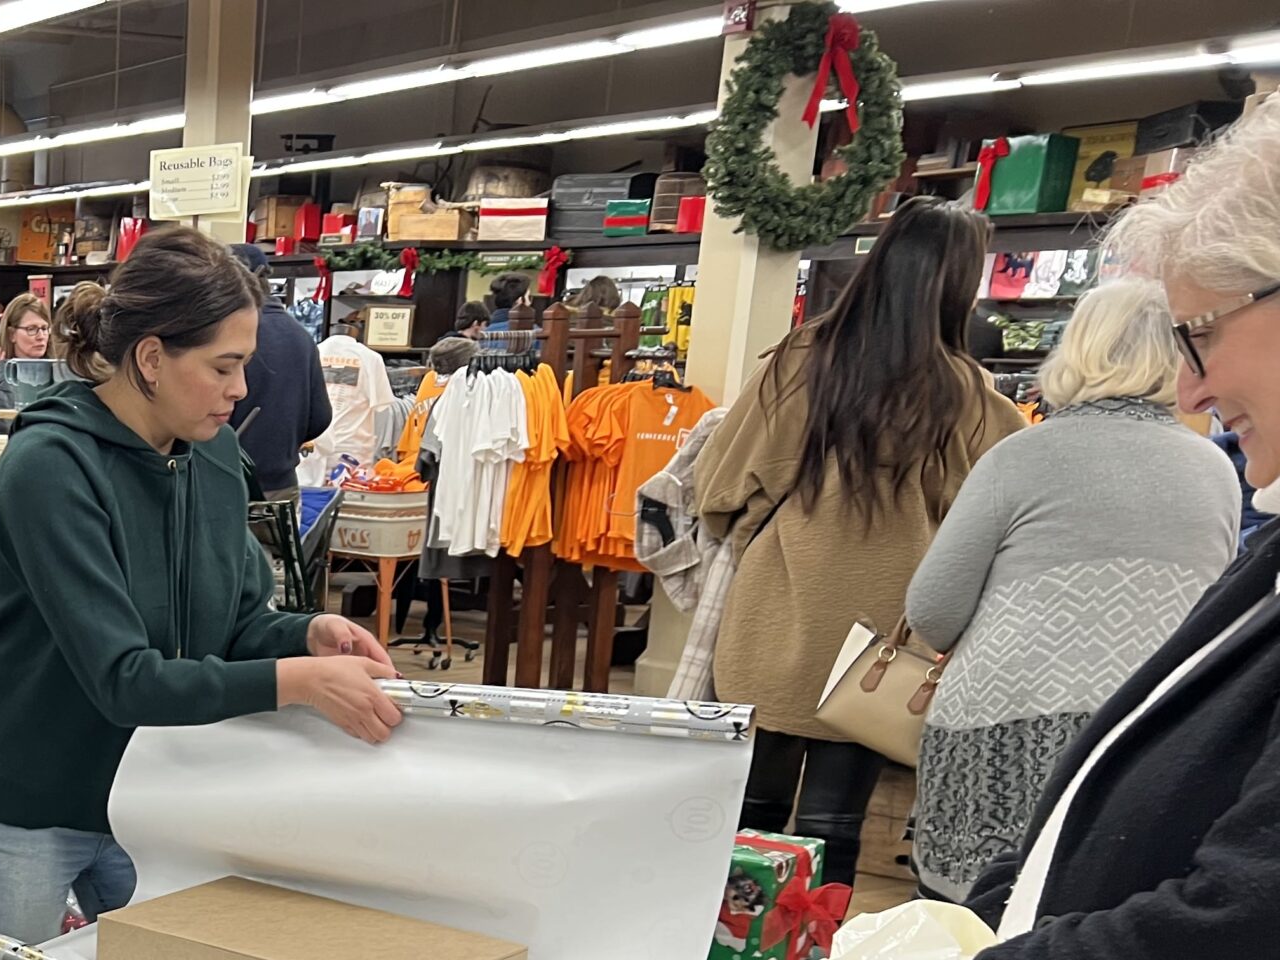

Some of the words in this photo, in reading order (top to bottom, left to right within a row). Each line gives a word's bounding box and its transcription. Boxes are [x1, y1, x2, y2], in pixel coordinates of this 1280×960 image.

[159, 158, 206, 171] Reusable
[208, 156, 233, 169] Bags
[391, 312, 407, 320] OFF
